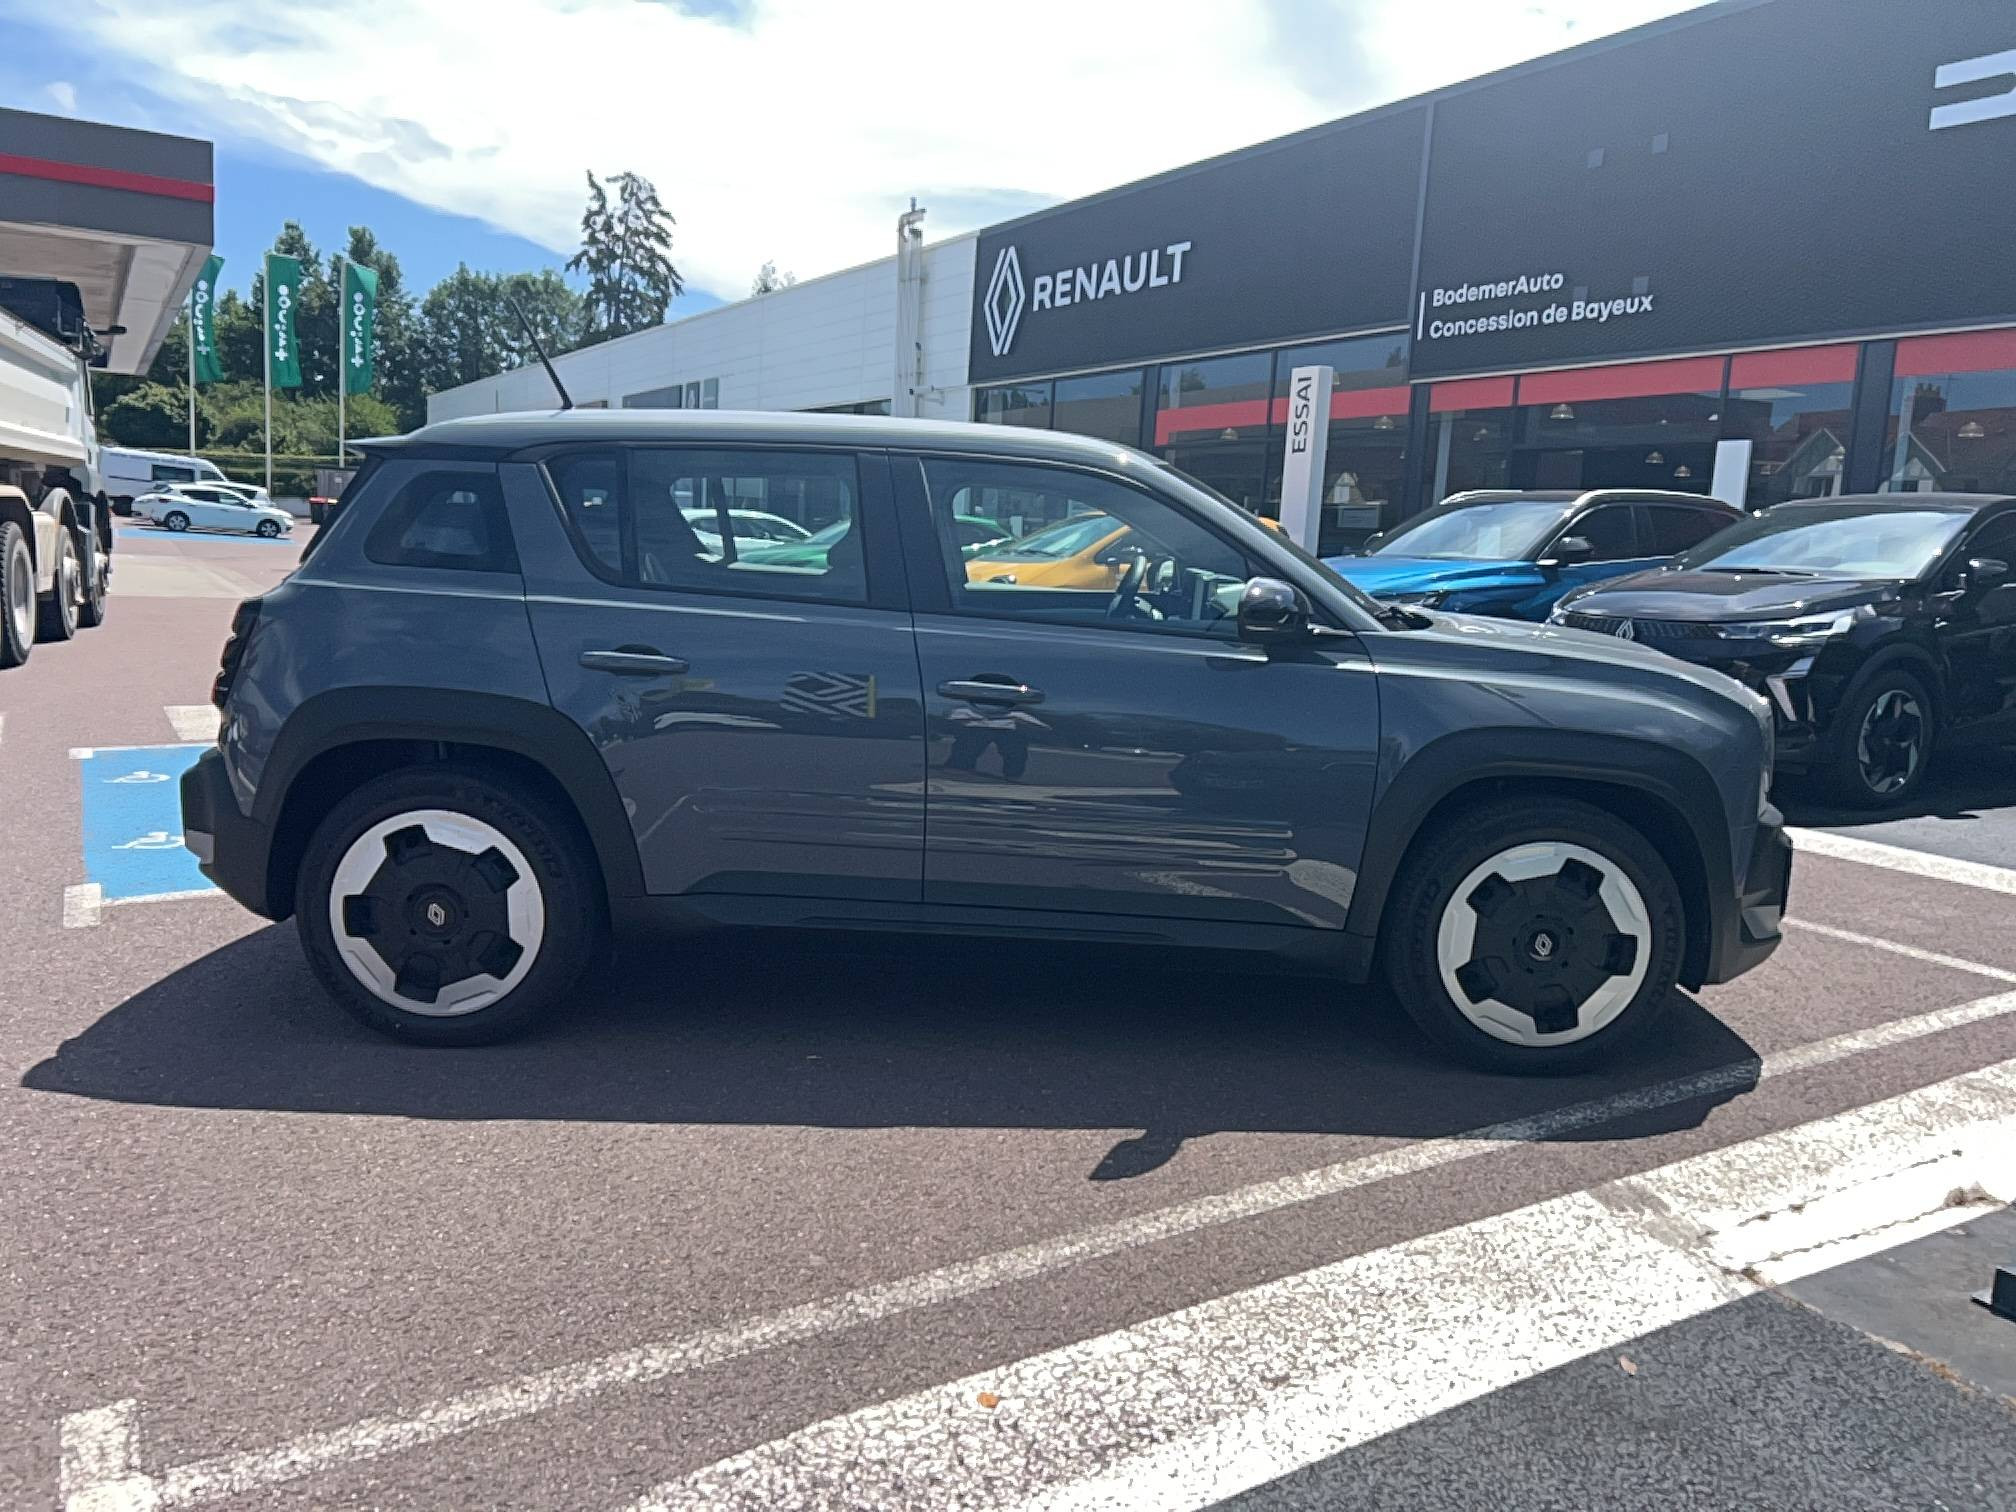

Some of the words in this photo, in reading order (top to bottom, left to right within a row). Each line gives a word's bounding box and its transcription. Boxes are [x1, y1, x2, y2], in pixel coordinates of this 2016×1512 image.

[1032, 240, 1192, 312] RENAULT
[1432, 272, 1564, 308] BodemerAuto
[1429, 309, 1539, 339] Concession
[1542, 303, 1568, 325] de
[1571, 294, 1654, 323] Bayeux
[1291, 375, 1313, 455] ESSAI
